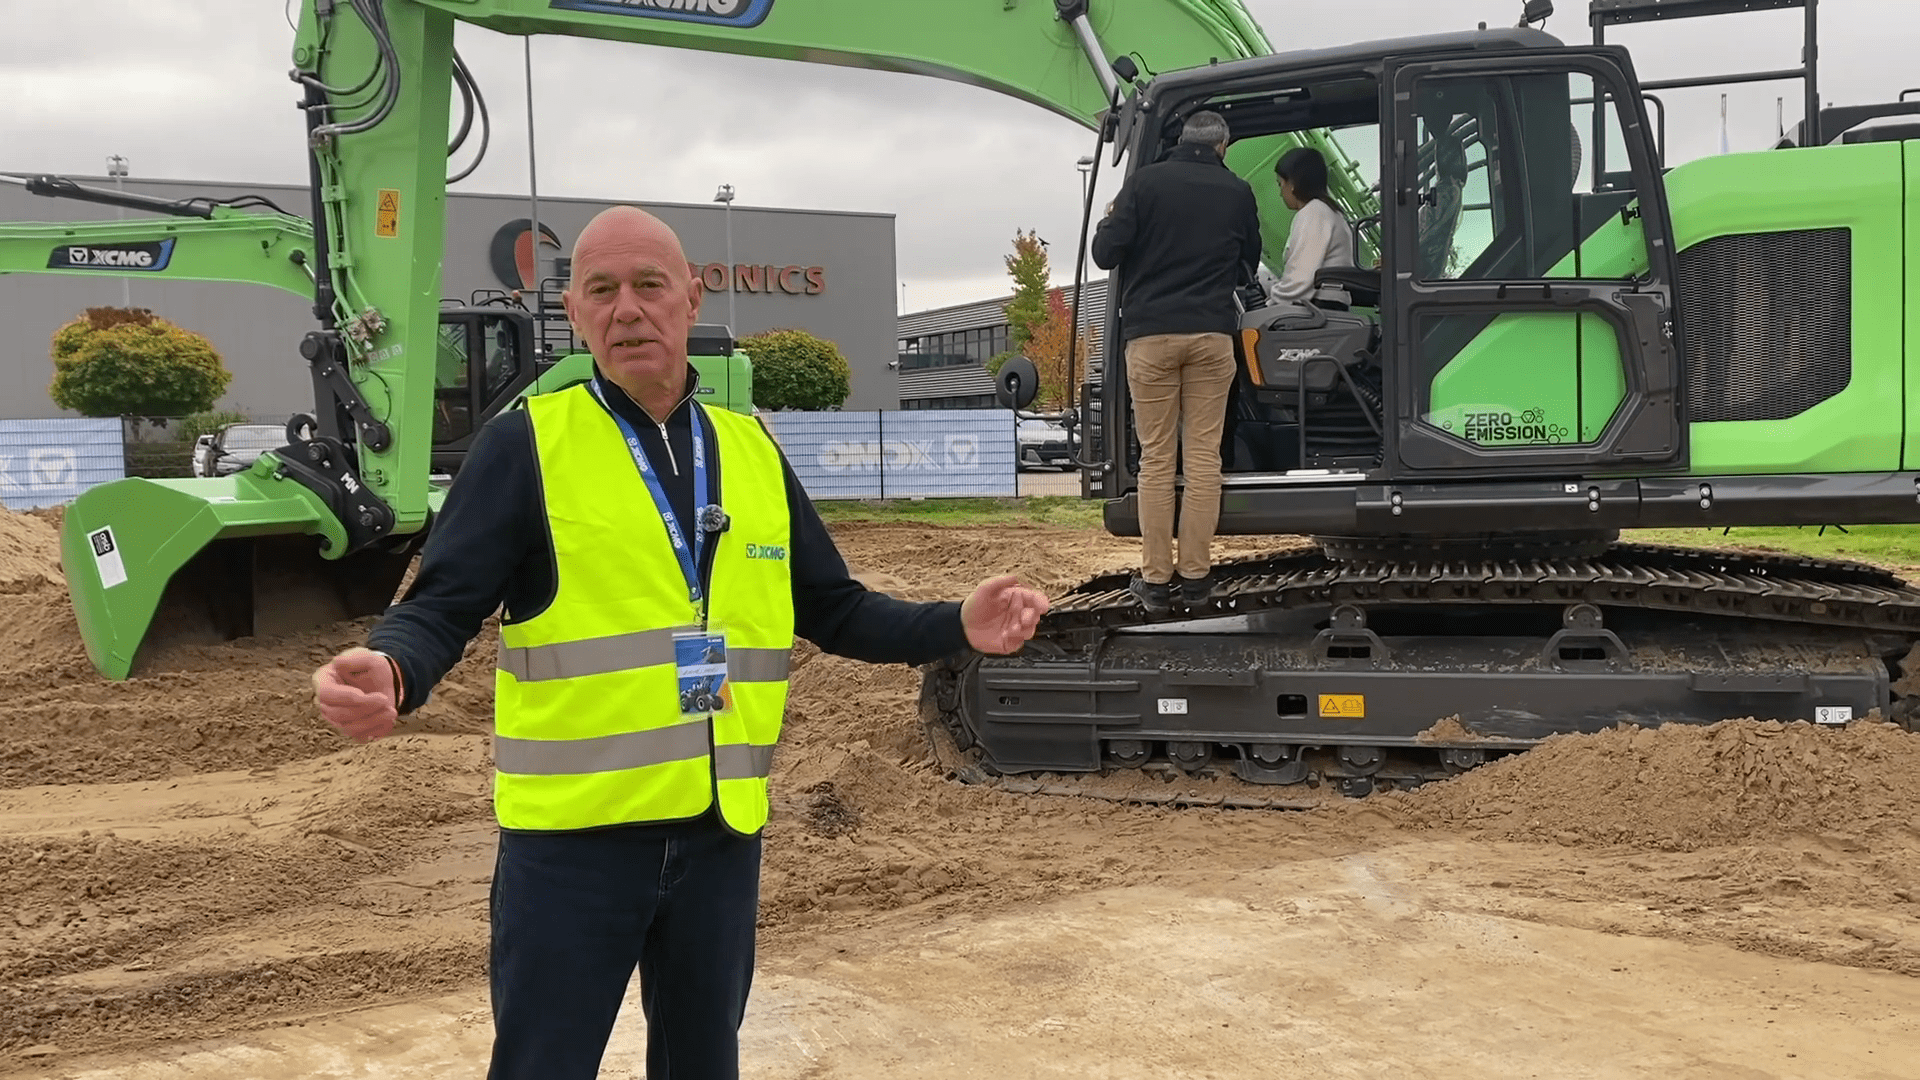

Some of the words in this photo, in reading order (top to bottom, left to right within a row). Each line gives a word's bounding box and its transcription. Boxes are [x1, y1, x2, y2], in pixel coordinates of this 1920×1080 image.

[89, 249, 153, 266] XCMG
[688, 262, 826, 295] ONICS
[1464, 412, 1512, 428] ZERO
[1464, 424, 1546, 441] EMISSION
[758, 545, 786, 560] XCMG
